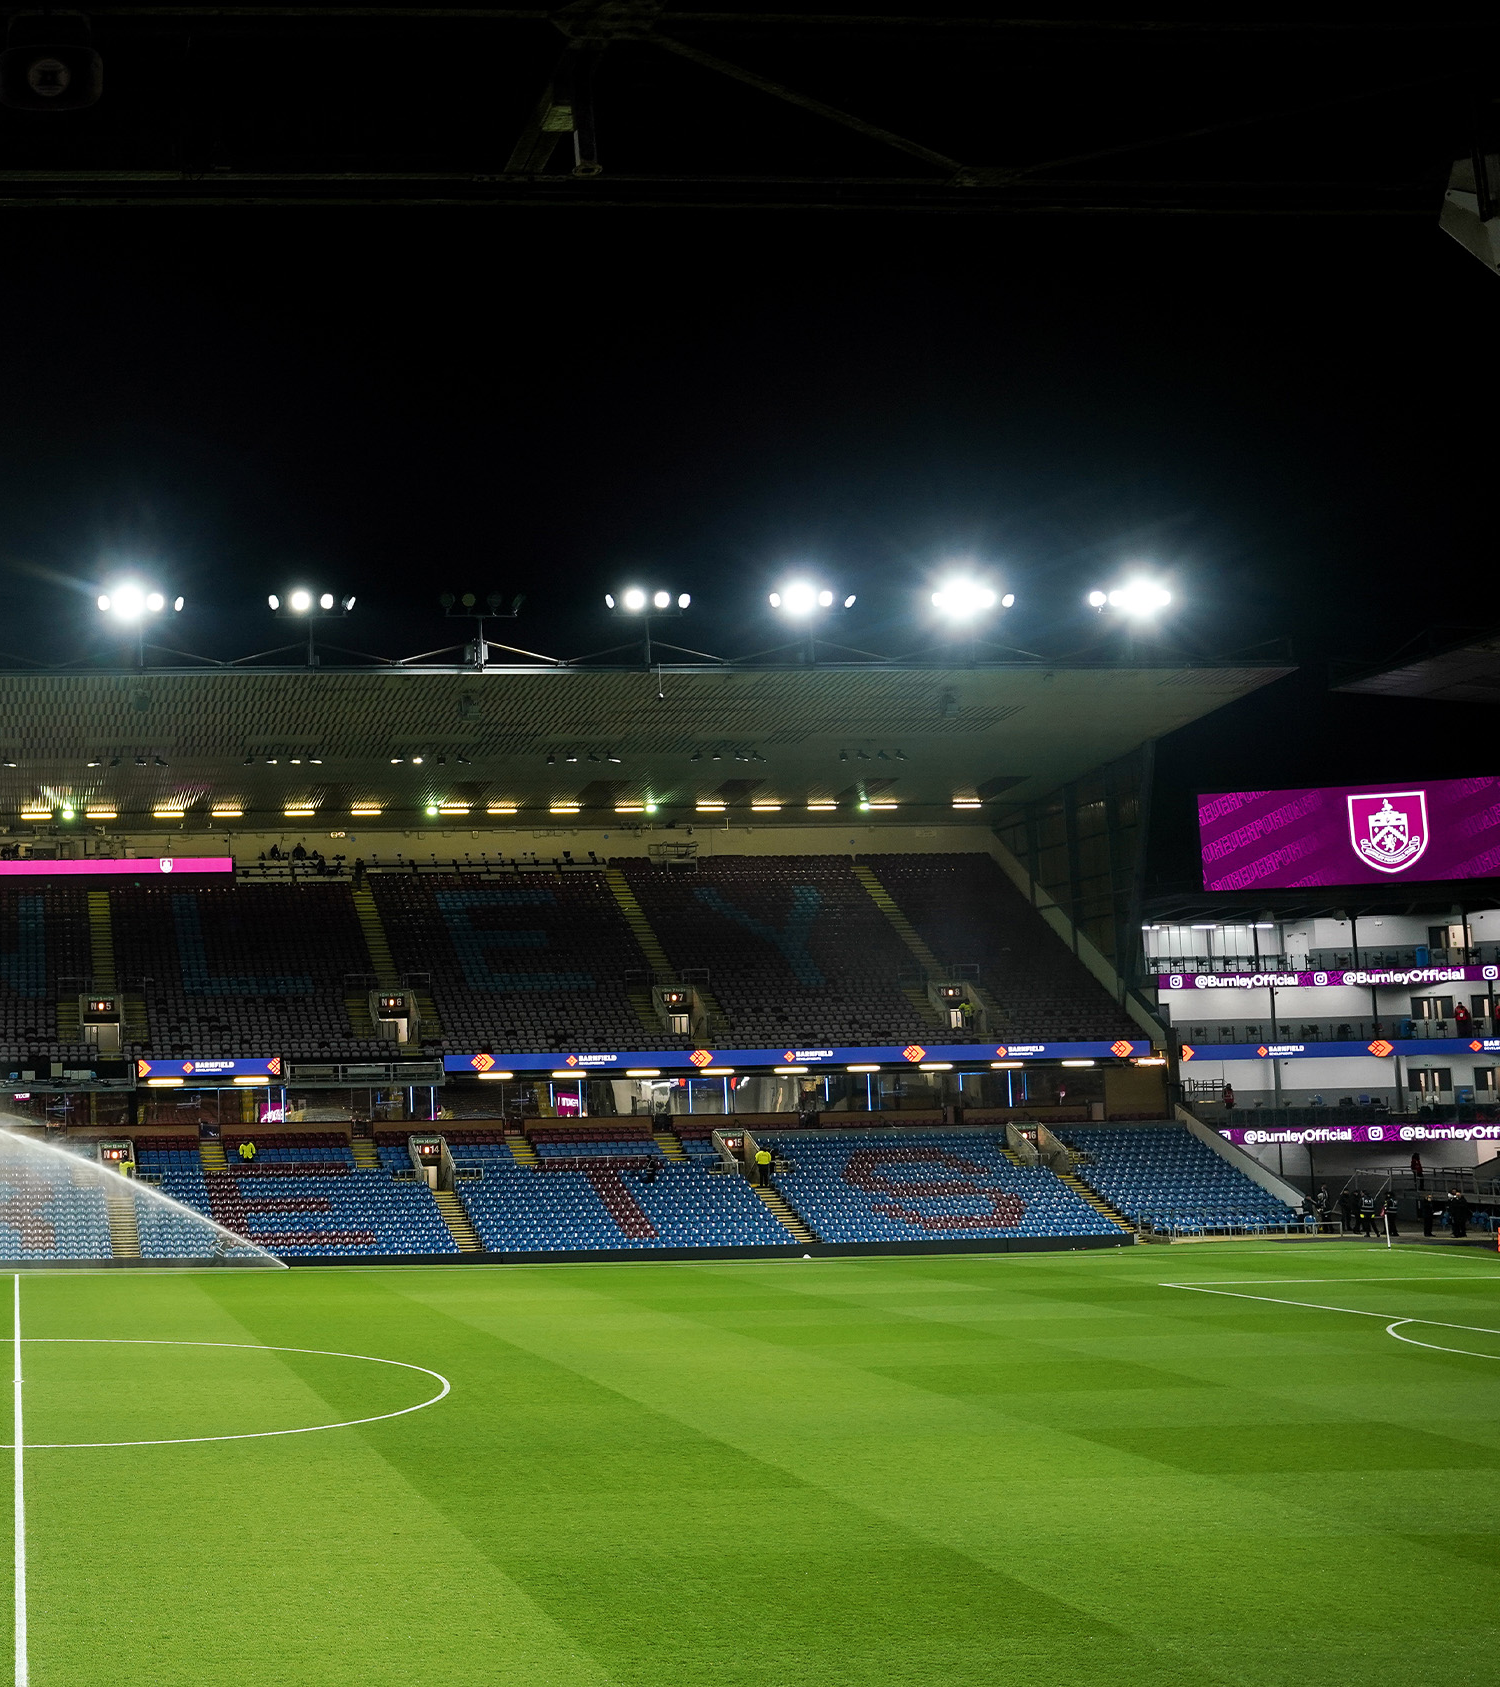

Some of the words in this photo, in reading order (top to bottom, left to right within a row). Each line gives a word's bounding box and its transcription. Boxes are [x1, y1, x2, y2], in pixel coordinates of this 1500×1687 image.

[1195, 974, 1298, 989] @BurnleyOfficial
[1342, 968, 1465, 985] @BurnleyOfficial
[1244, 1128, 1352, 1144] @BurnleyOfficial
